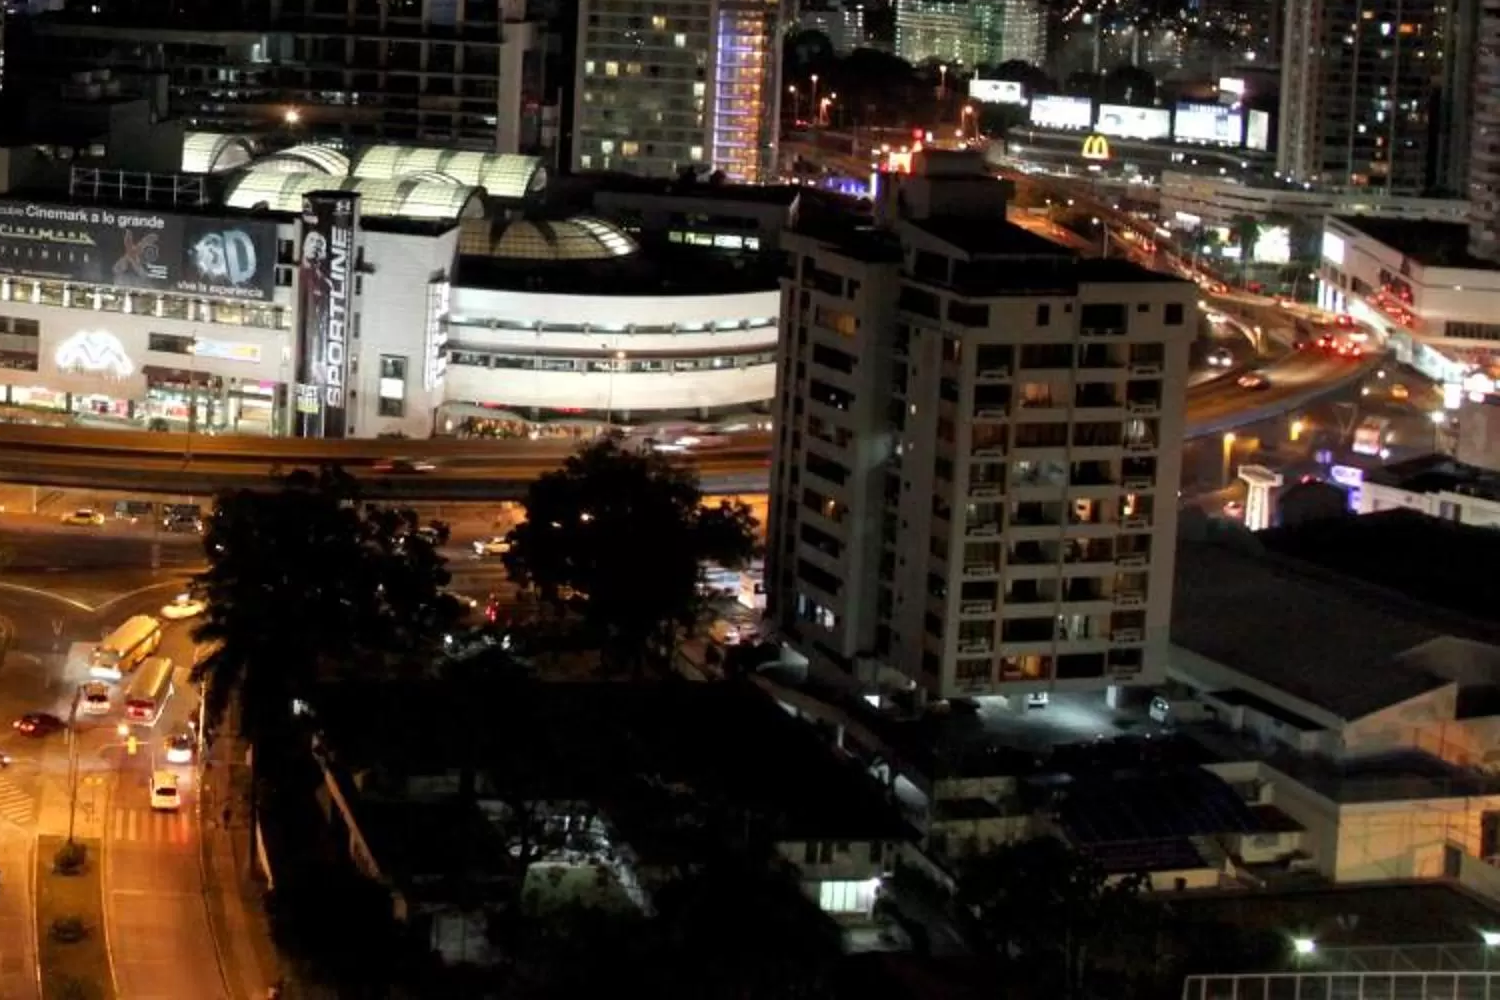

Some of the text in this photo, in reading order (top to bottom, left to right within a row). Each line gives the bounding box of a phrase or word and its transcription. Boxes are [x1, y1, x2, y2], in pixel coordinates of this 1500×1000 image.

[25, 204, 89, 225] Cinemark
[91, 212, 100, 224] a
[102, 210, 116, 225] lo
[118, 213, 165, 230] grande
[326, 227, 350, 408] SPORTLINE
